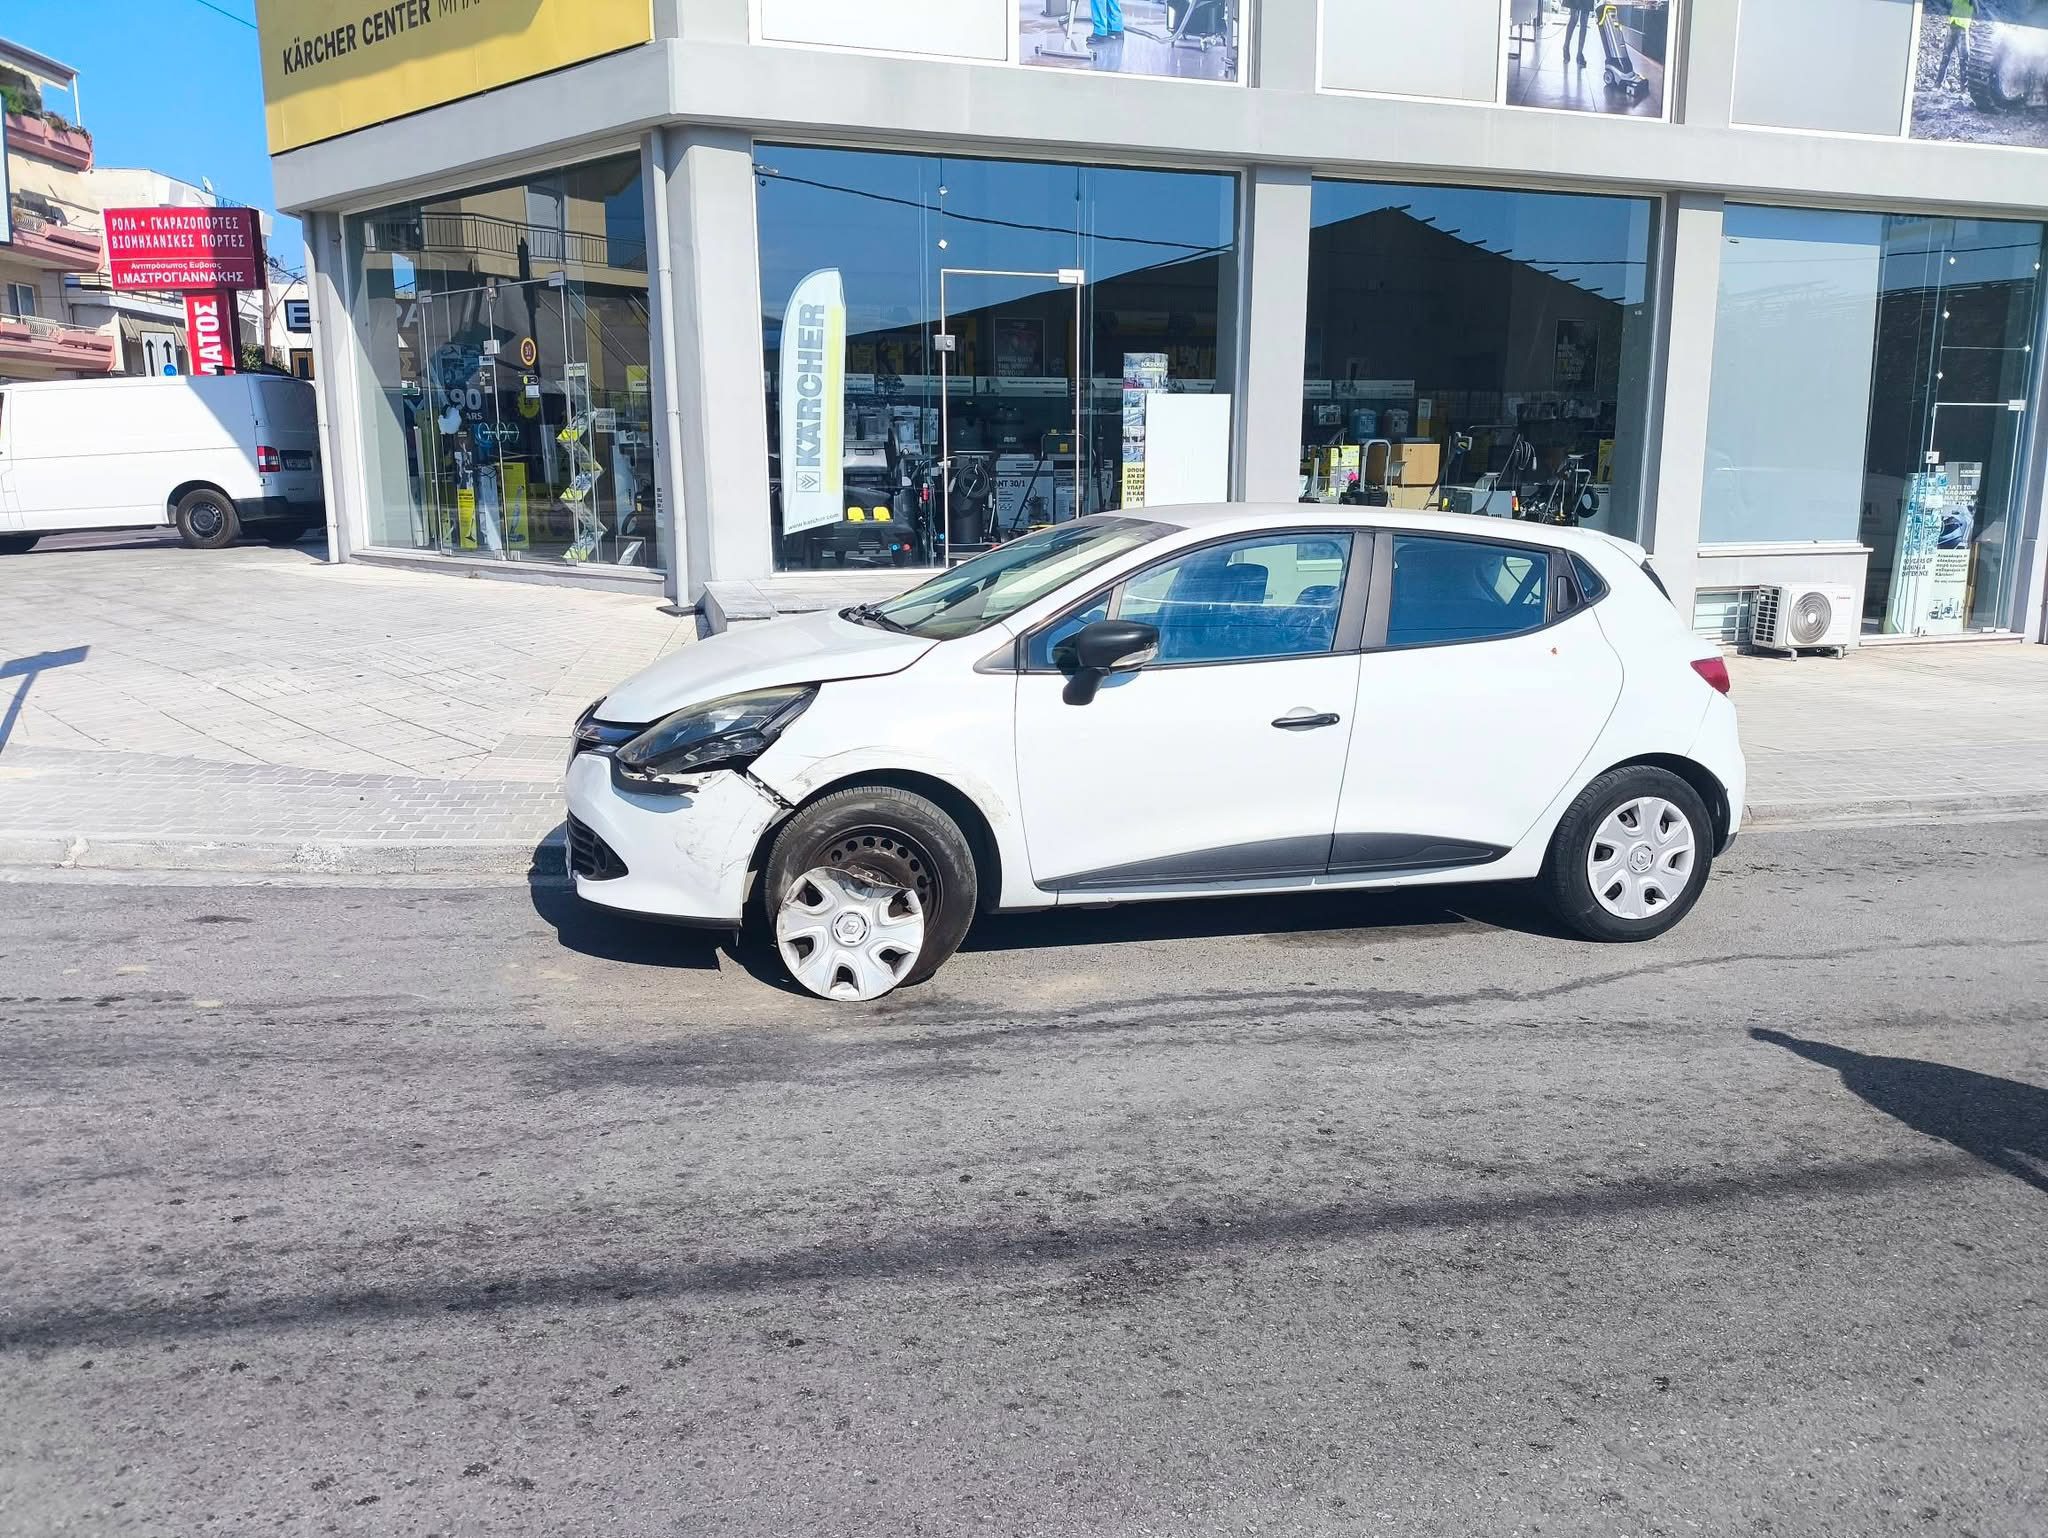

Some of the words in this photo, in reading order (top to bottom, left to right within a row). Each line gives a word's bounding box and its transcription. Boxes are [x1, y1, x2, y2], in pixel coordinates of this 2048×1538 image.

[283, 23, 358, 75] KÄRCHER
[362, 0, 431, 45] CENTER
[112, 217, 137, 232] ΡΟΛΑ
[151, 216, 239, 231] ΓΚΑΡΑΖΟΠΟΡΤΕΣ
[112, 234, 195, 249] ΒΙΟΜΗΧΑΝΙΚΕΣ
[201, 234, 245, 248] ΠΟΡΤΕΣ
[796, 303, 825, 467] KÄRCHER
[450, 388, 482, 410] 90
